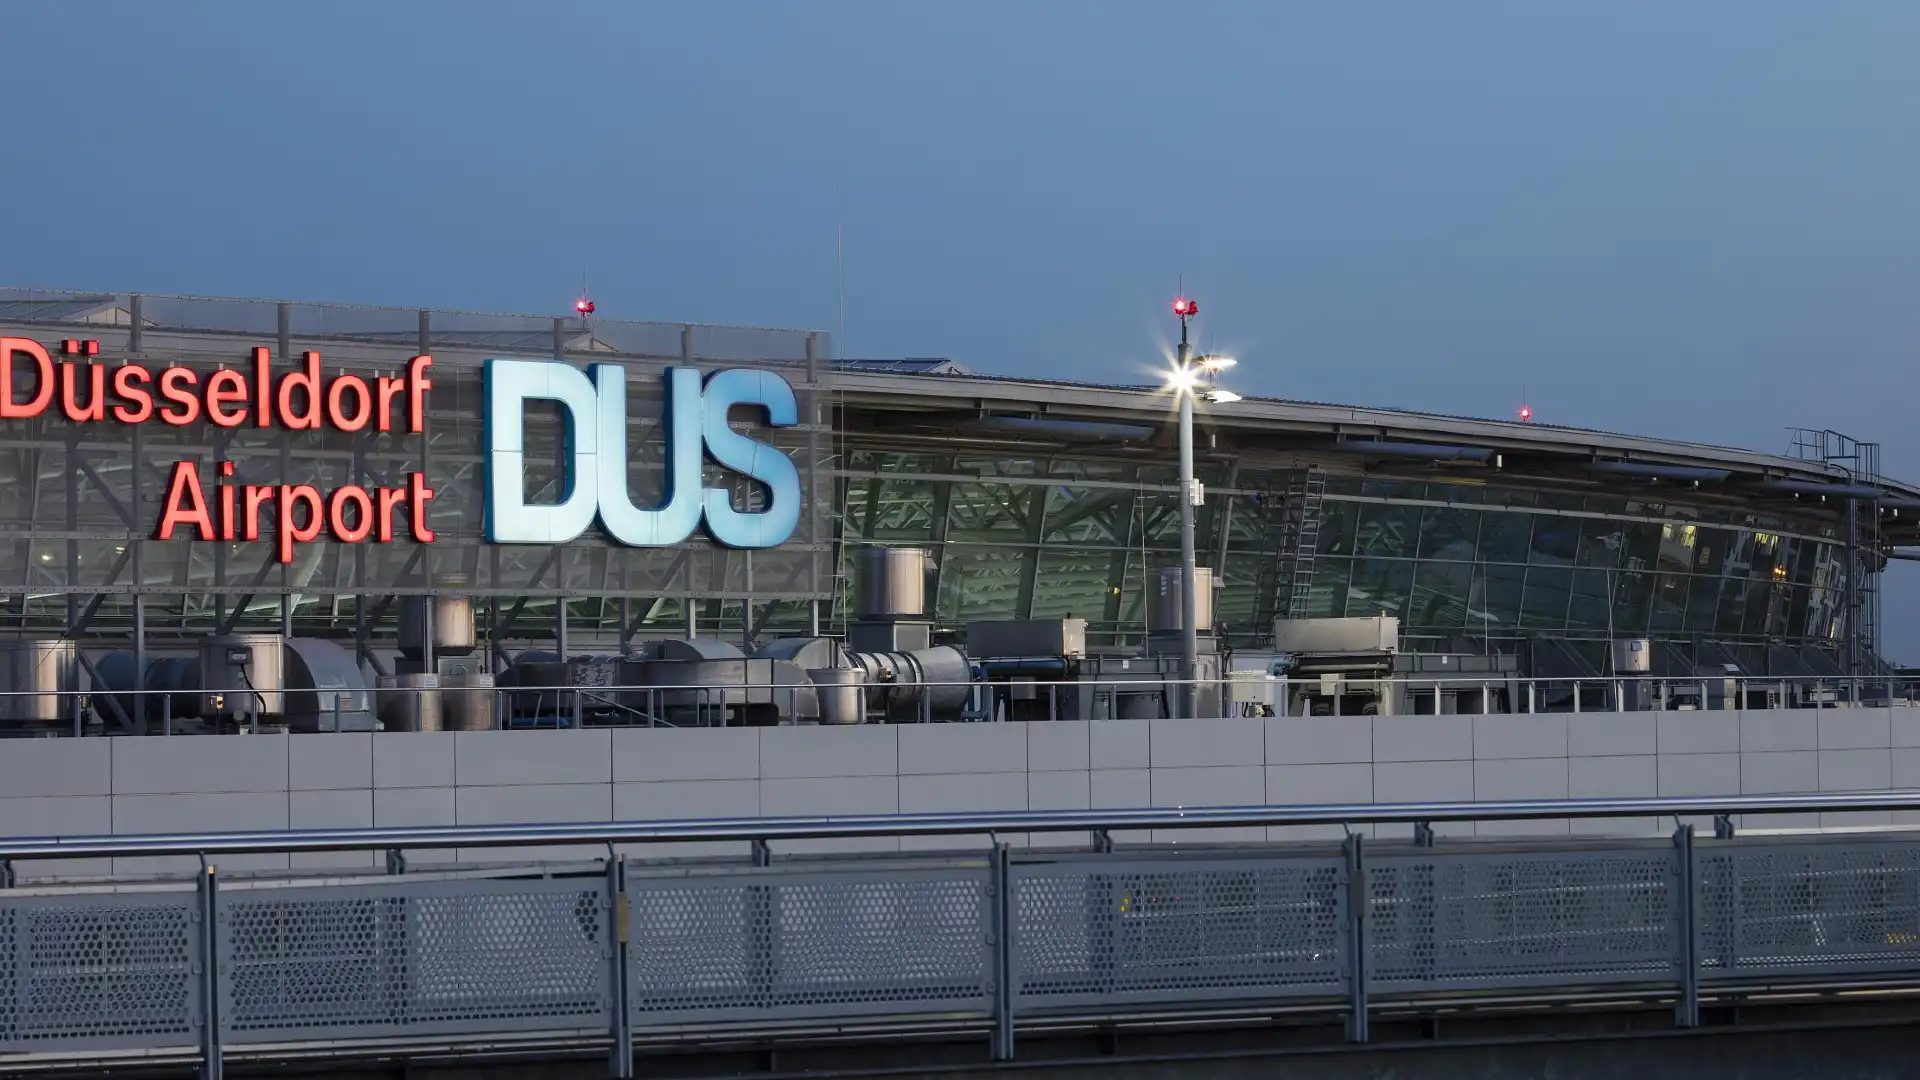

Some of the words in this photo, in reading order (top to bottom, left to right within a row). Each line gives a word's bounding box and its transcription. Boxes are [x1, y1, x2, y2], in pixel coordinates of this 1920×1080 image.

[0, 336, 434, 433] Düsseldorf
[484, 358, 801, 549] DUS
[155, 461, 435, 563] Airport
